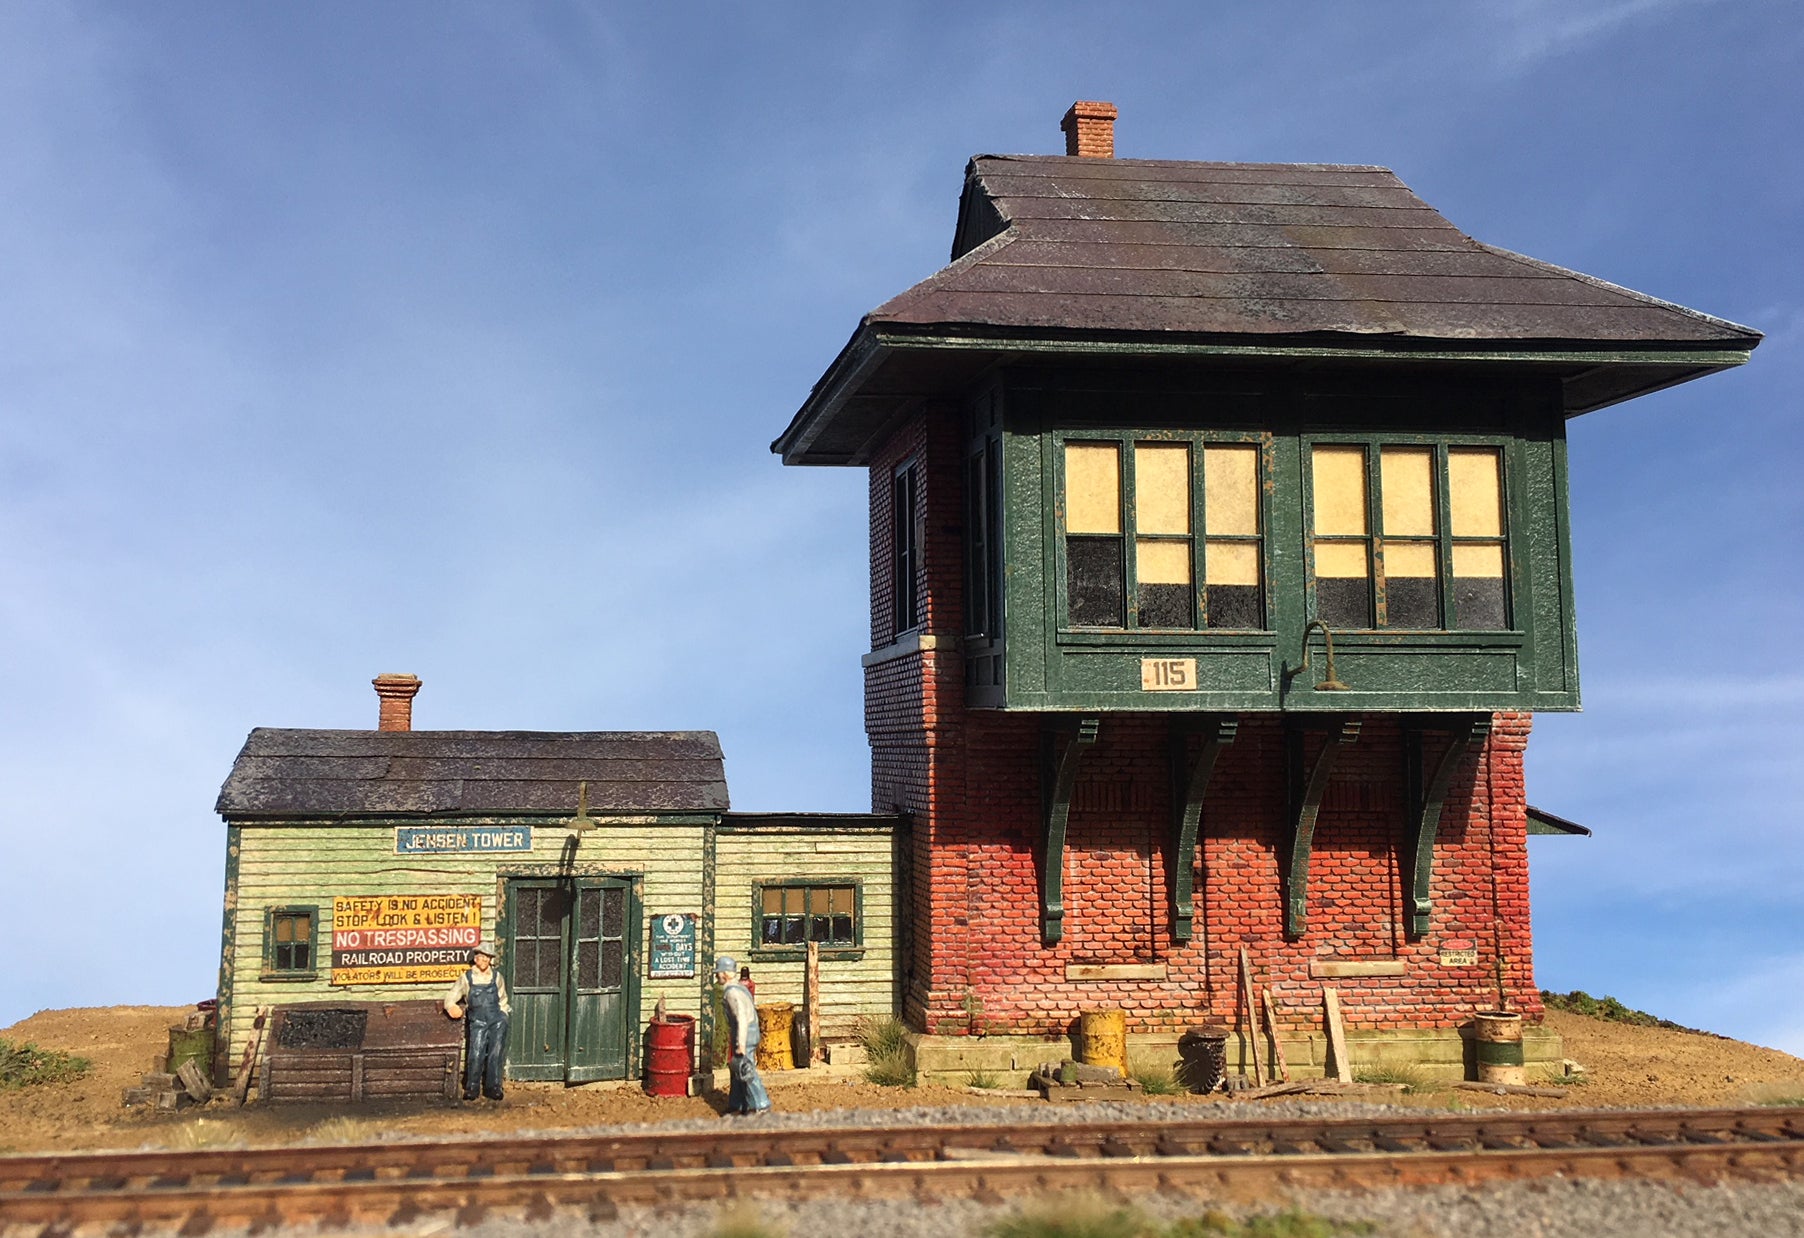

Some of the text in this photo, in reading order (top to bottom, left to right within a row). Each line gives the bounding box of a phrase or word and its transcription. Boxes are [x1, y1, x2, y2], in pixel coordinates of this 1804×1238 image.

[1153, 661, 1185, 686] 115
[406, 832, 523, 849] JENSEN TOWER
[336, 897, 477, 912] SAFETY IS NO ACCIDENT
[376, 914, 408, 926] LOOK
[413, 914, 421, 925] &
[336, 928, 476, 947] NO TRESPASSING
[675, 943, 693, 951] DAYS
[341, 950, 470, 966] RAILROAD PROPERTY
[1449, 957, 1467, 965] AREA
[333, 969, 381, 982] VIOLATORS
[384, 969, 403, 980] WILL
[406, 969, 418, 979] BE
